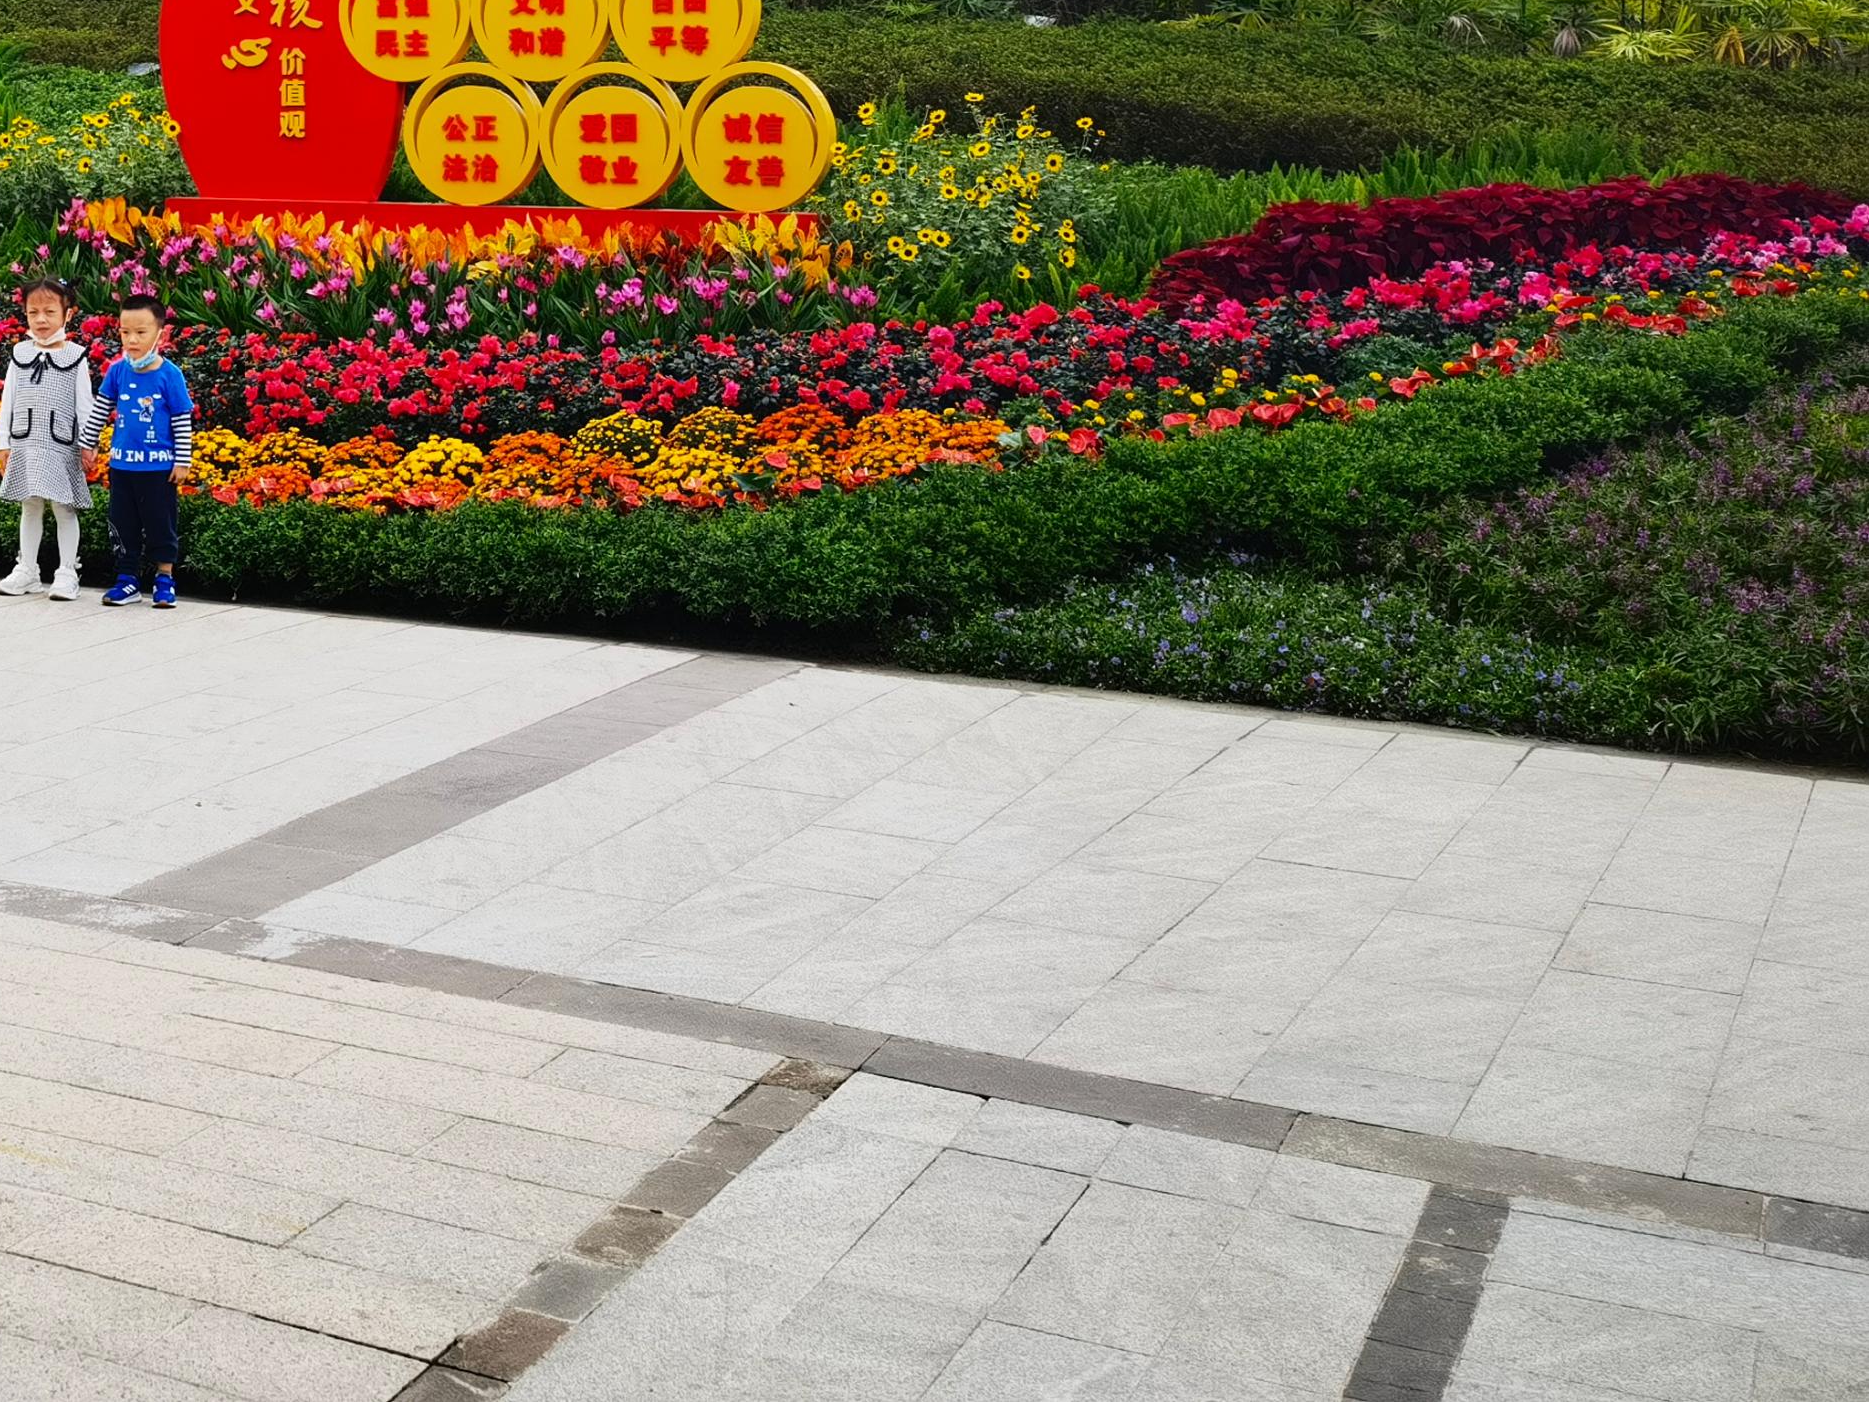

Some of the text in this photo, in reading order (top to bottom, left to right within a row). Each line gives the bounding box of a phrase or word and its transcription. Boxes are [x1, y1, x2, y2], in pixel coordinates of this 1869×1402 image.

[375, 30, 429, 58] 民主
[509, 27, 565, 57] 和谐
[649, 25, 709, 56] 平等
[278, 47, 306, 138] 价值观
[442, 114, 499, 142] 公正
[579, 113, 638, 143] 爱国
[722, 113, 784, 144] 诚信
[442, 154, 499, 183] 法治
[579, 155, 638, 185] 敬业
[723, 156, 784, 187] 友善
[125, 450, 144, 462] IN
